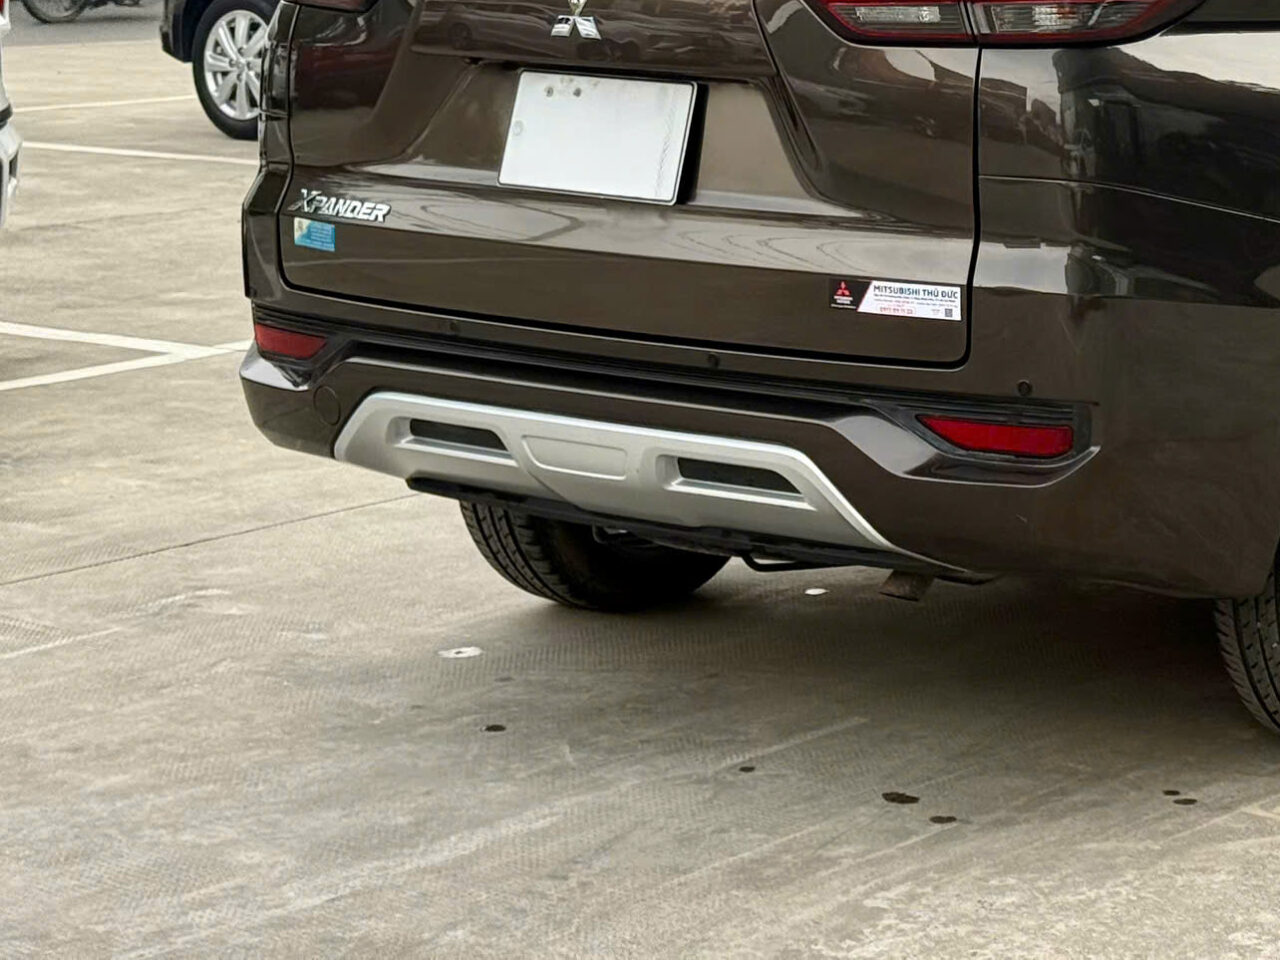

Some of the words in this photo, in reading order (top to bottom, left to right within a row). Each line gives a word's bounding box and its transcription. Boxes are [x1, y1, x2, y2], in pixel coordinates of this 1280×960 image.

[288, 189, 391, 222] XPANDER
[873, 285, 921, 297] MITSUBISHI
[922, 287, 939, 298] THỦ
[941, 289, 958, 299] ĐỨC
